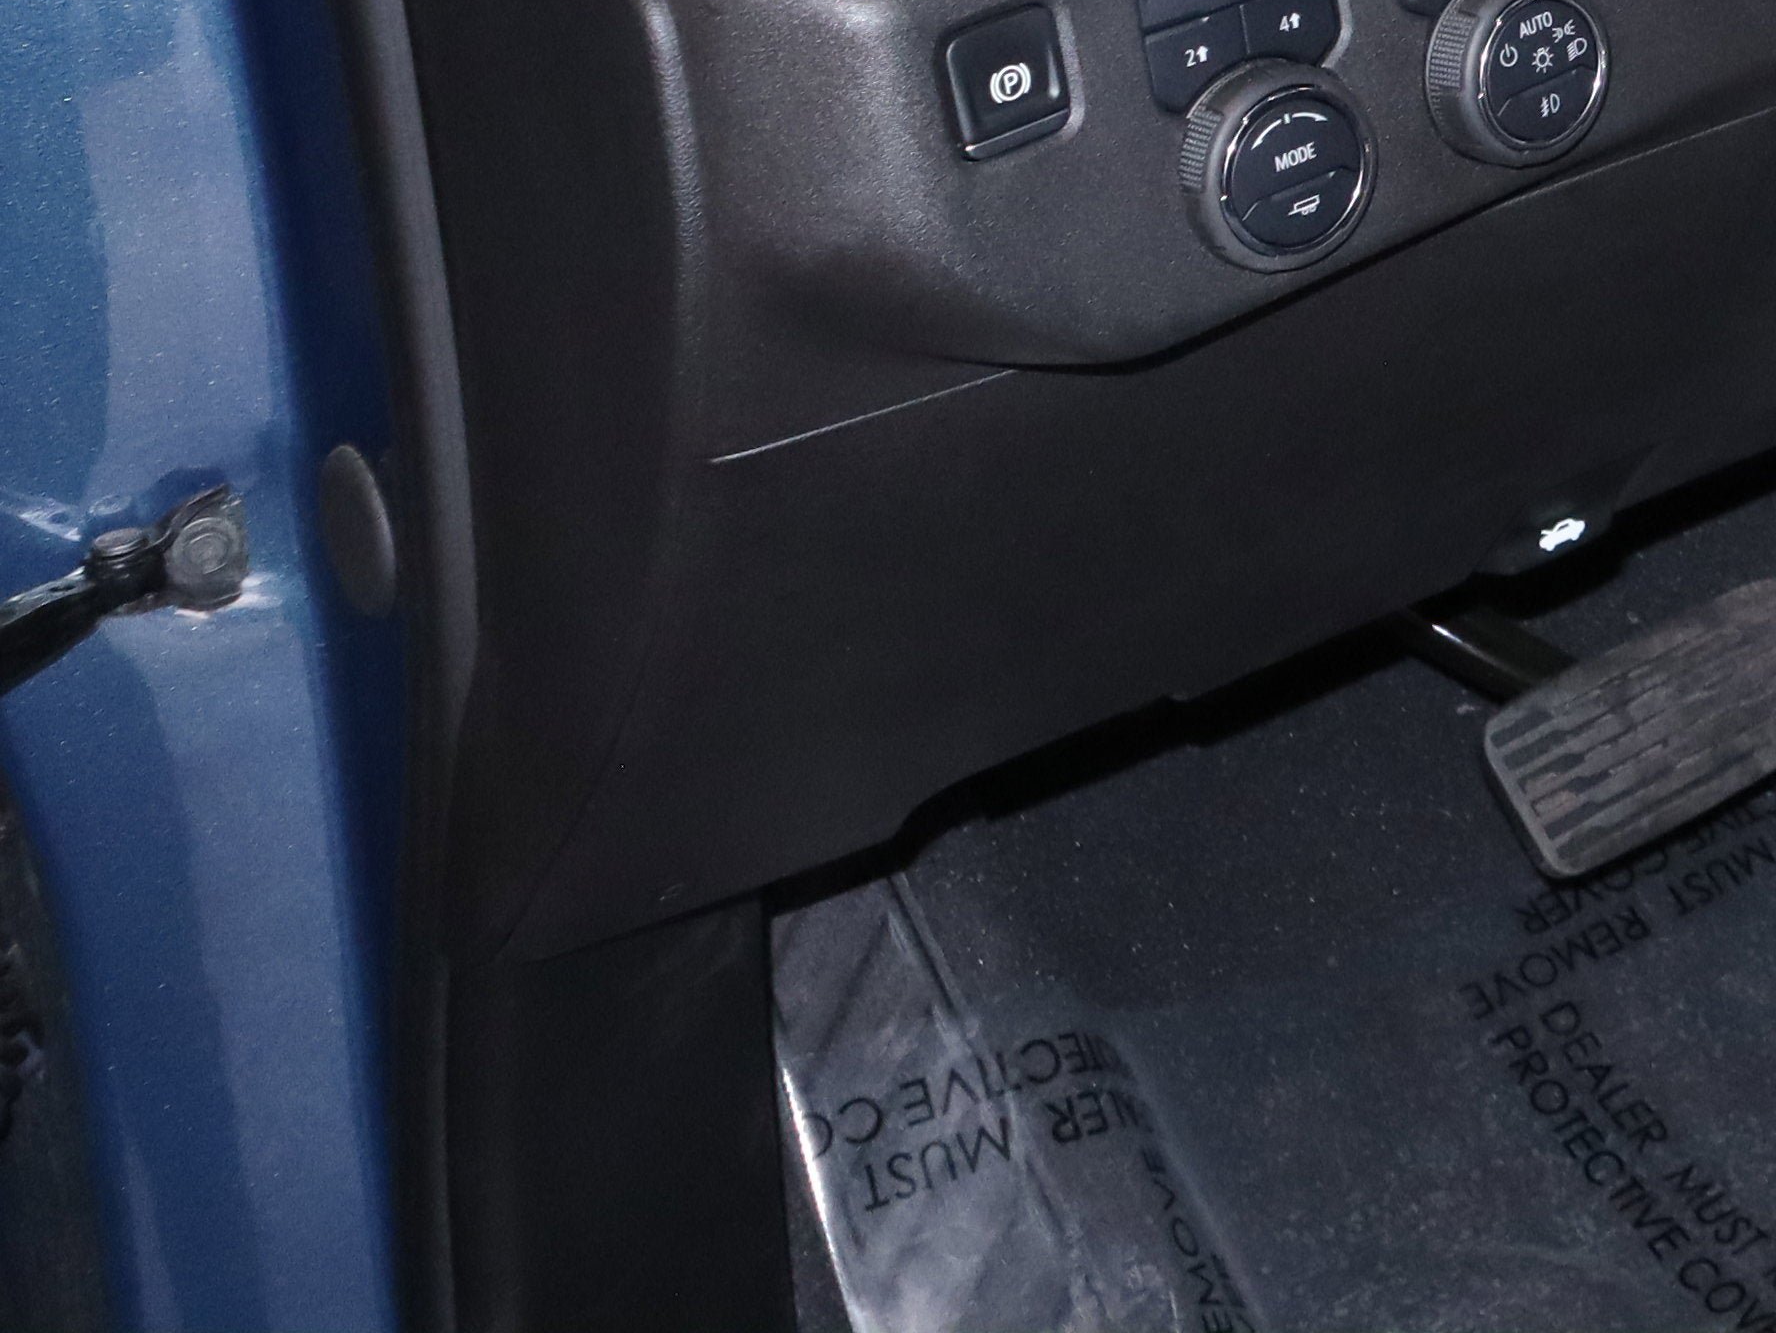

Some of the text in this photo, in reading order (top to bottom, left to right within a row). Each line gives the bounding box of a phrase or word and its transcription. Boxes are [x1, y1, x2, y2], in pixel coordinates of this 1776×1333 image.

[1518, 11, 1554, 39] AUTO
[1273, 141, 1318, 172] MODE
[1458, 905, 1651, 1021] REMOVE
[863, 1118, 1012, 1213] MUST
[1488, 1023, 1692, 1264] PROTECTIVE
[1539, 999, 1668, 1155] DEALER
[1661, 1161, 1772, 1256] MUST
